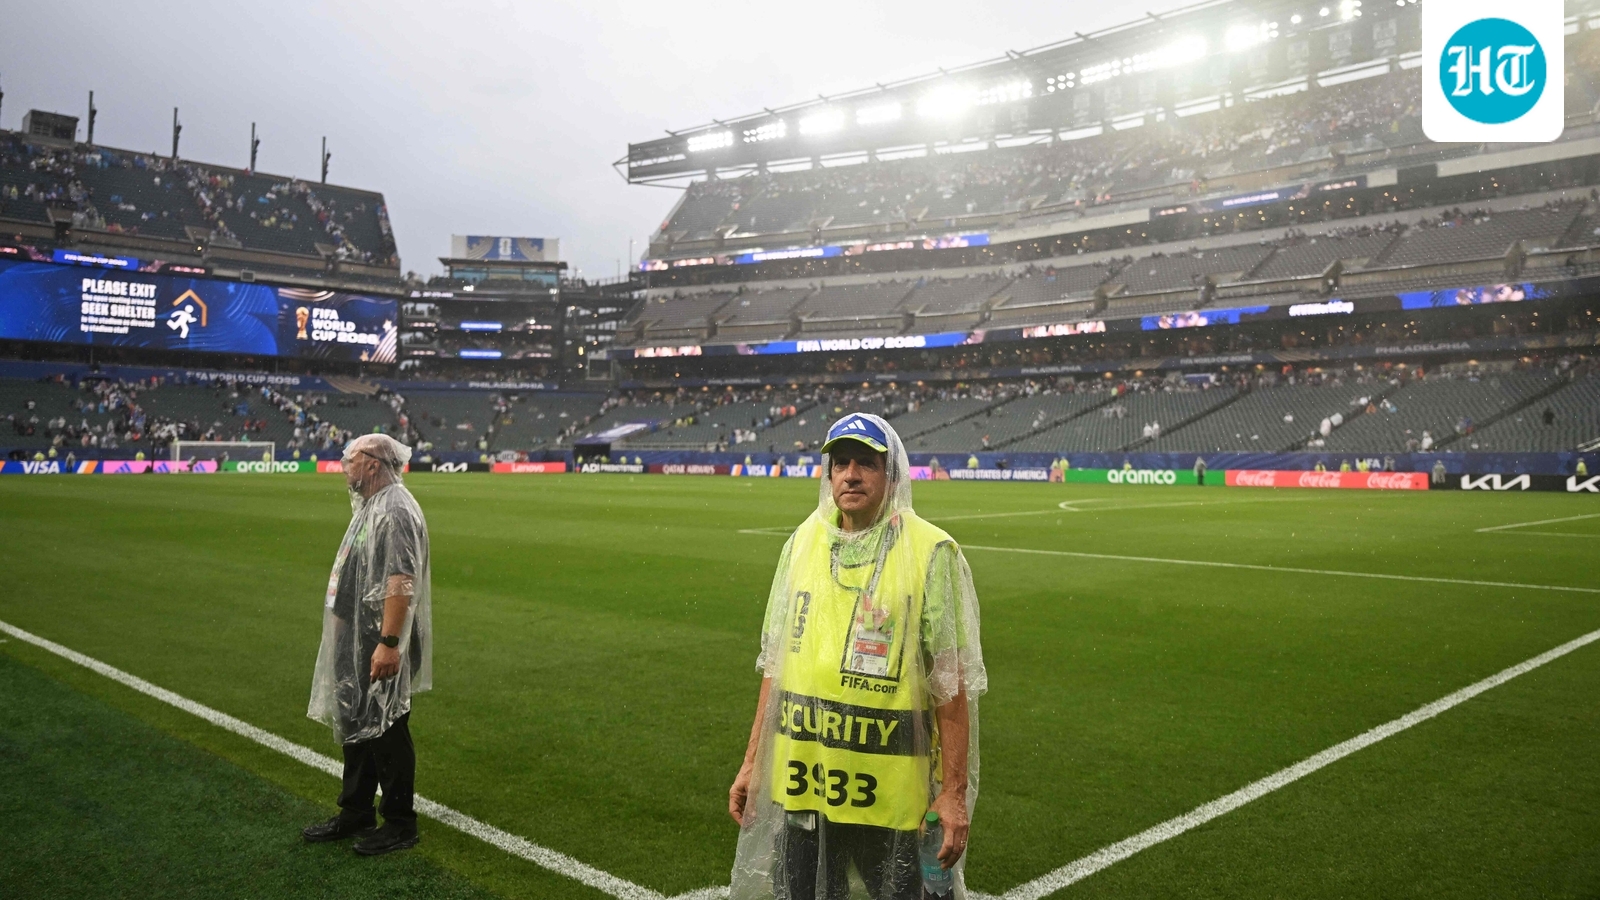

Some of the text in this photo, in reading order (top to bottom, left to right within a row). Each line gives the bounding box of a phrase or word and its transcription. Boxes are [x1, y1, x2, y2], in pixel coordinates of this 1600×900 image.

[82, 278, 157, 298] PLEASE EXIT
[81, 302, 155, 319] SEEK SHELTER
[312, 307, 339, 320] FIFA
[312, 319, 356, 332] WORLD
[311, 330, 379, 345] CUP 2026
[796, 340, 820, 352] FIFA
[820, 339, 860, 351] WORLD
[860, 338, 885, 350] CUP
[1375, 341, 1470, 354] PHILADELPHIA
[186, 370, 207, 381] FFA
[246, 374, 266, 383] CUP
[266, 376, 300, 385] 2026
[468, 381, 544, 389] PHILADELPHIA
[21, 461, 60, 474] VISA
[236, 461, 299, 473] aramco
[511, 463, 546, 473] Lenovo
[581, 463, 600, 473] ADI
[662, 464, 716, 474] QATAR AIRWAYS
[747, 465, 767, 477] VISA
[786, 465, 808, 477] VISA
[949, 469, 1048, 481] UNITED STATES OF AMERICA
[1107, 469, 1177, 484] aramco
[1460, 474, 1531, 491] KIA
[841, 675, 898, 694] FIFA.com
[781, 700, 899, 747] SCURITY
[786, 760, 878, 808] 3933
